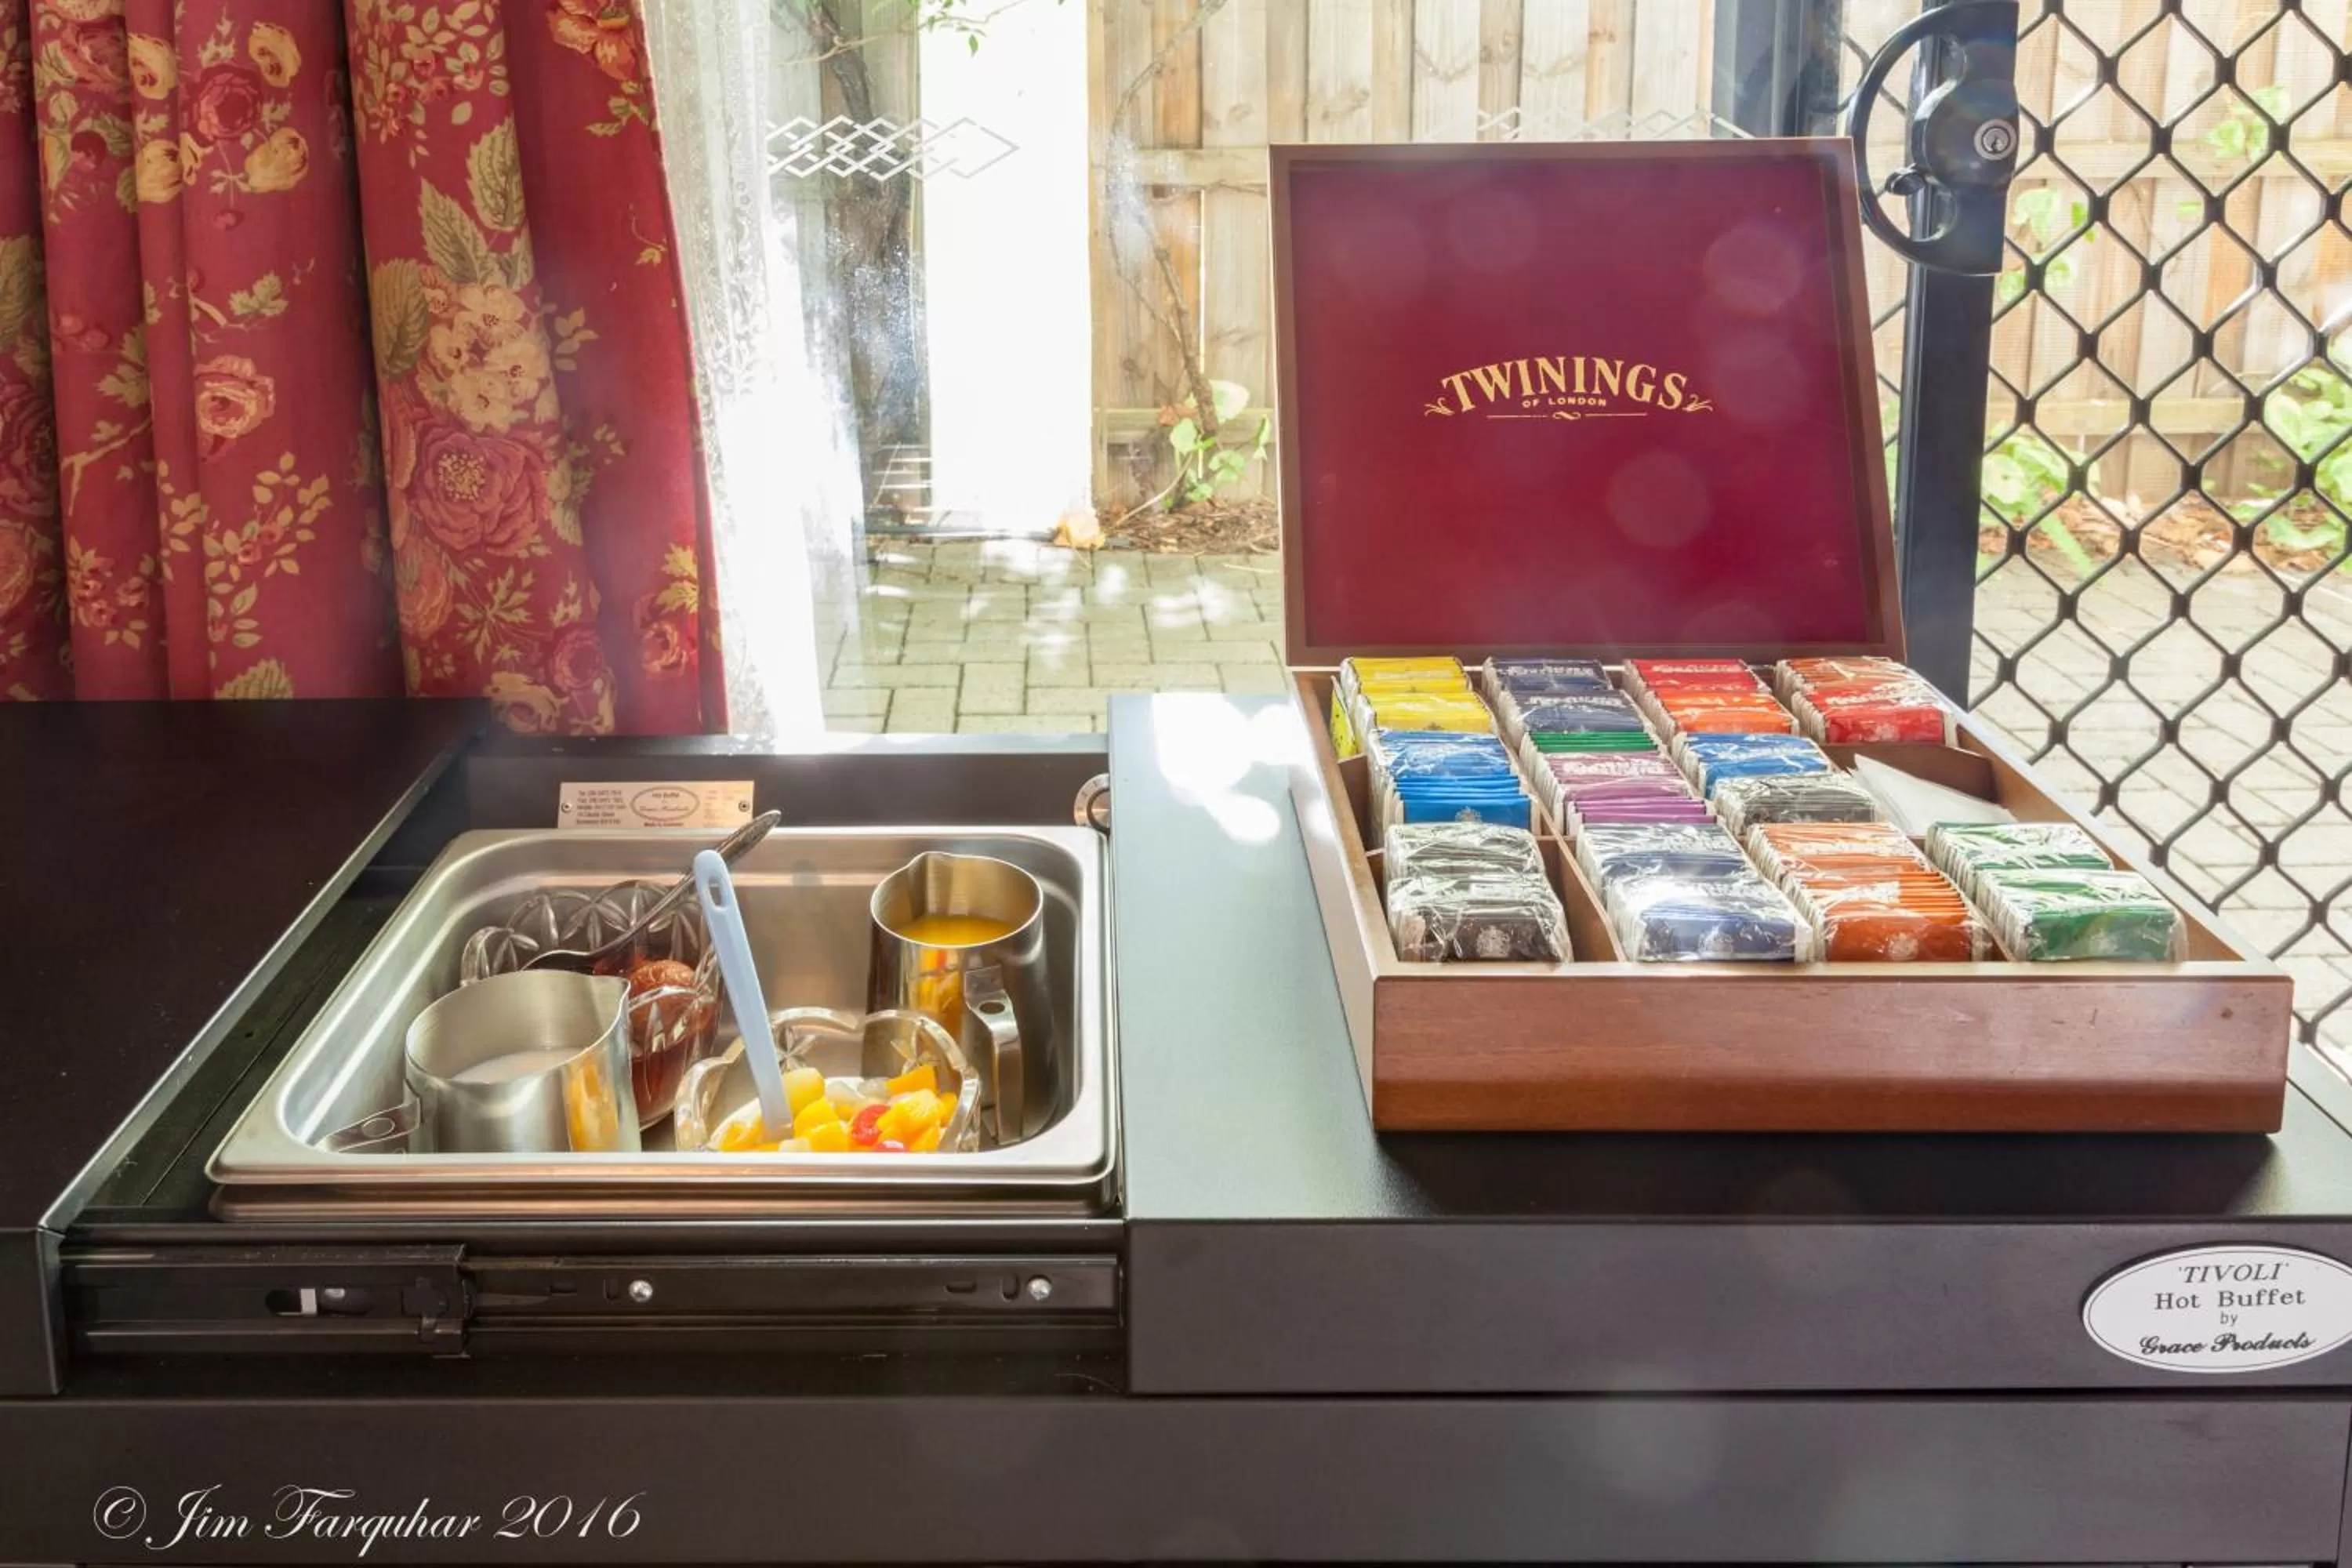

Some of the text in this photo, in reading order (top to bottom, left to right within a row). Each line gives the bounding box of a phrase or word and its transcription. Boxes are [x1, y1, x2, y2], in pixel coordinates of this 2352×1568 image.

[1441, 356, 1687, 412] TWININGS
[1522, 397, 1607, 408] OF LONDON
[2155, 1289, 2306, 1309] Hot Buffet
[2220, 1312, 2238, 1327] by
[2139, 1332, 2314, 1355] Grace Products
